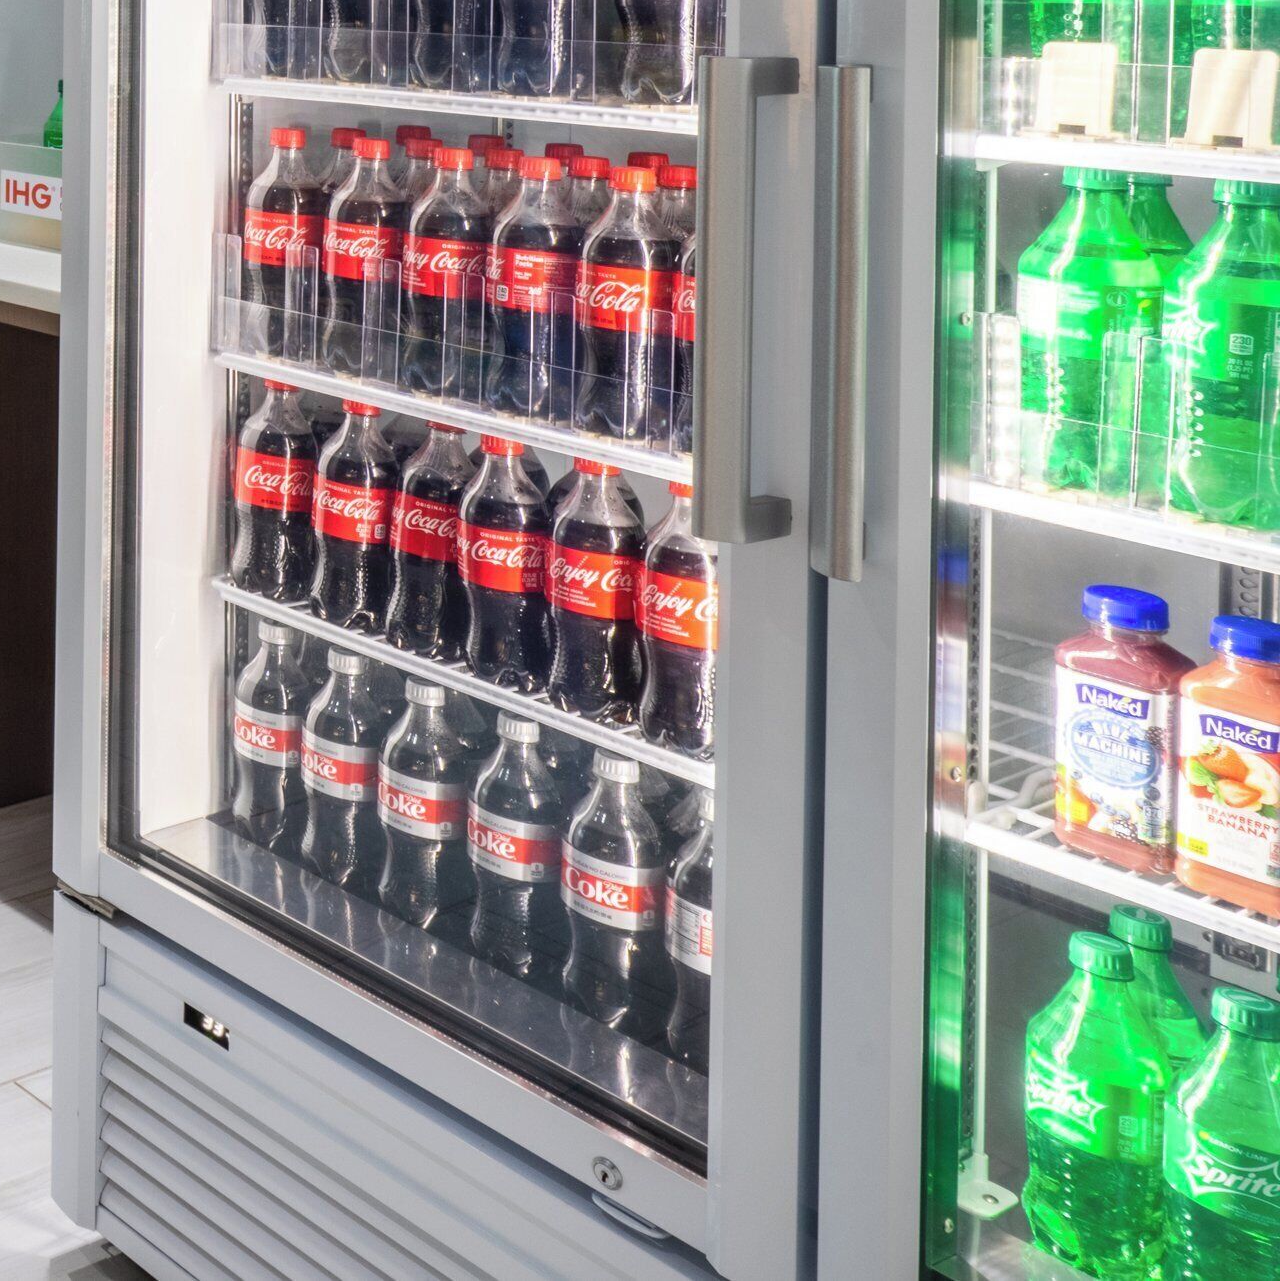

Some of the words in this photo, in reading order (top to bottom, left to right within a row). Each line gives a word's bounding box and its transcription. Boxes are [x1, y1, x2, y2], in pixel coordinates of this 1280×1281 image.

[5, 178, 52, 209] IHG
[1231, 336, 1251, 346] 230
[318, 490, 384, 521] Coca-Cola
[415, 501, 447, 512] ORIGINAL
[480, 532, 513, 543] ORIGINAL
[471, 539, 547, 568] Coca-Cola
[549, 557, 600, 589] Enjoy
[641, 584, 693, 616] Enjoy
[234, 716, 276, 750] Coke
[1094, 721, 1130, 741] BLUE
[1073, 730, 1151, 766] MACHINE
[378, 781, 427, 820] Coke
[1197, 803, 1280, 834] STRAWBERRY
[1207, 814, 1268, 840] BANANA
[467, 818, 517, 860] Coke
[493, 831, 512, 843] Diet
[565, 867, 630, 910] Coke
[603, 881, 624, 893] Diet
[1208, 1136, 1270, 1163] LEMON-LIME
